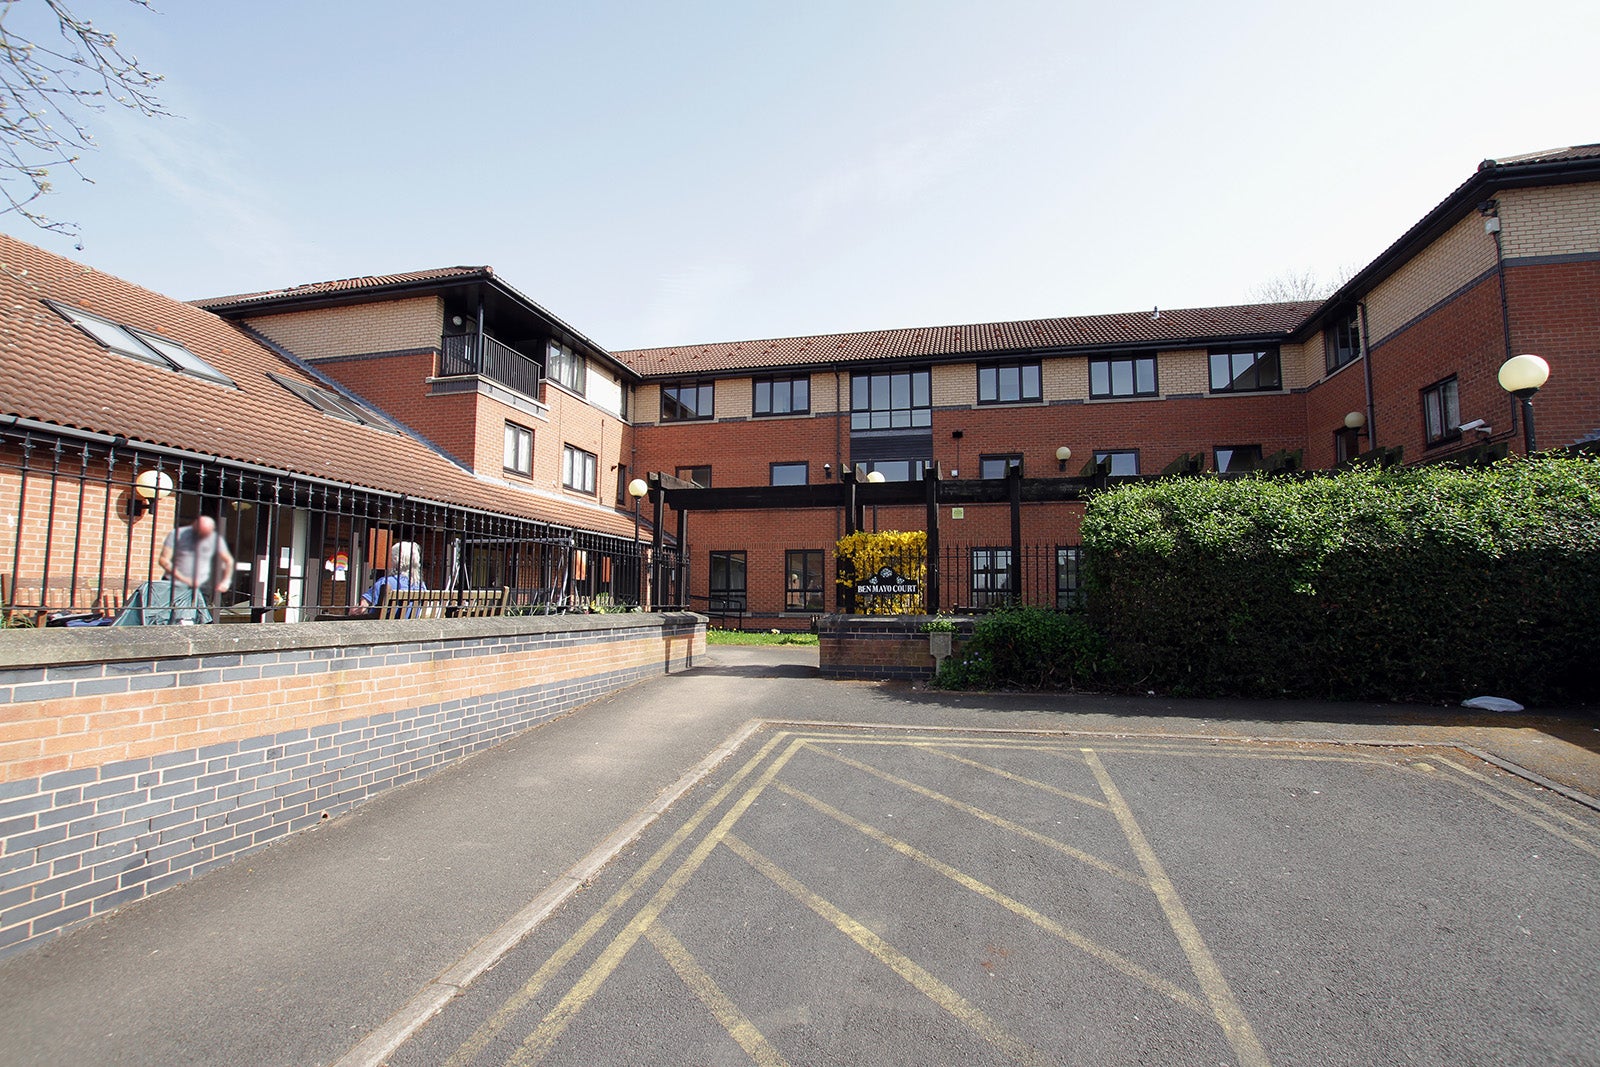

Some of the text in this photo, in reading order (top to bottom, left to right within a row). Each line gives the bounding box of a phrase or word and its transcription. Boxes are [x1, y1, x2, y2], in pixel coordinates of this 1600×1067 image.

[857, 585, 916, 593] BEN MAYO COURT
